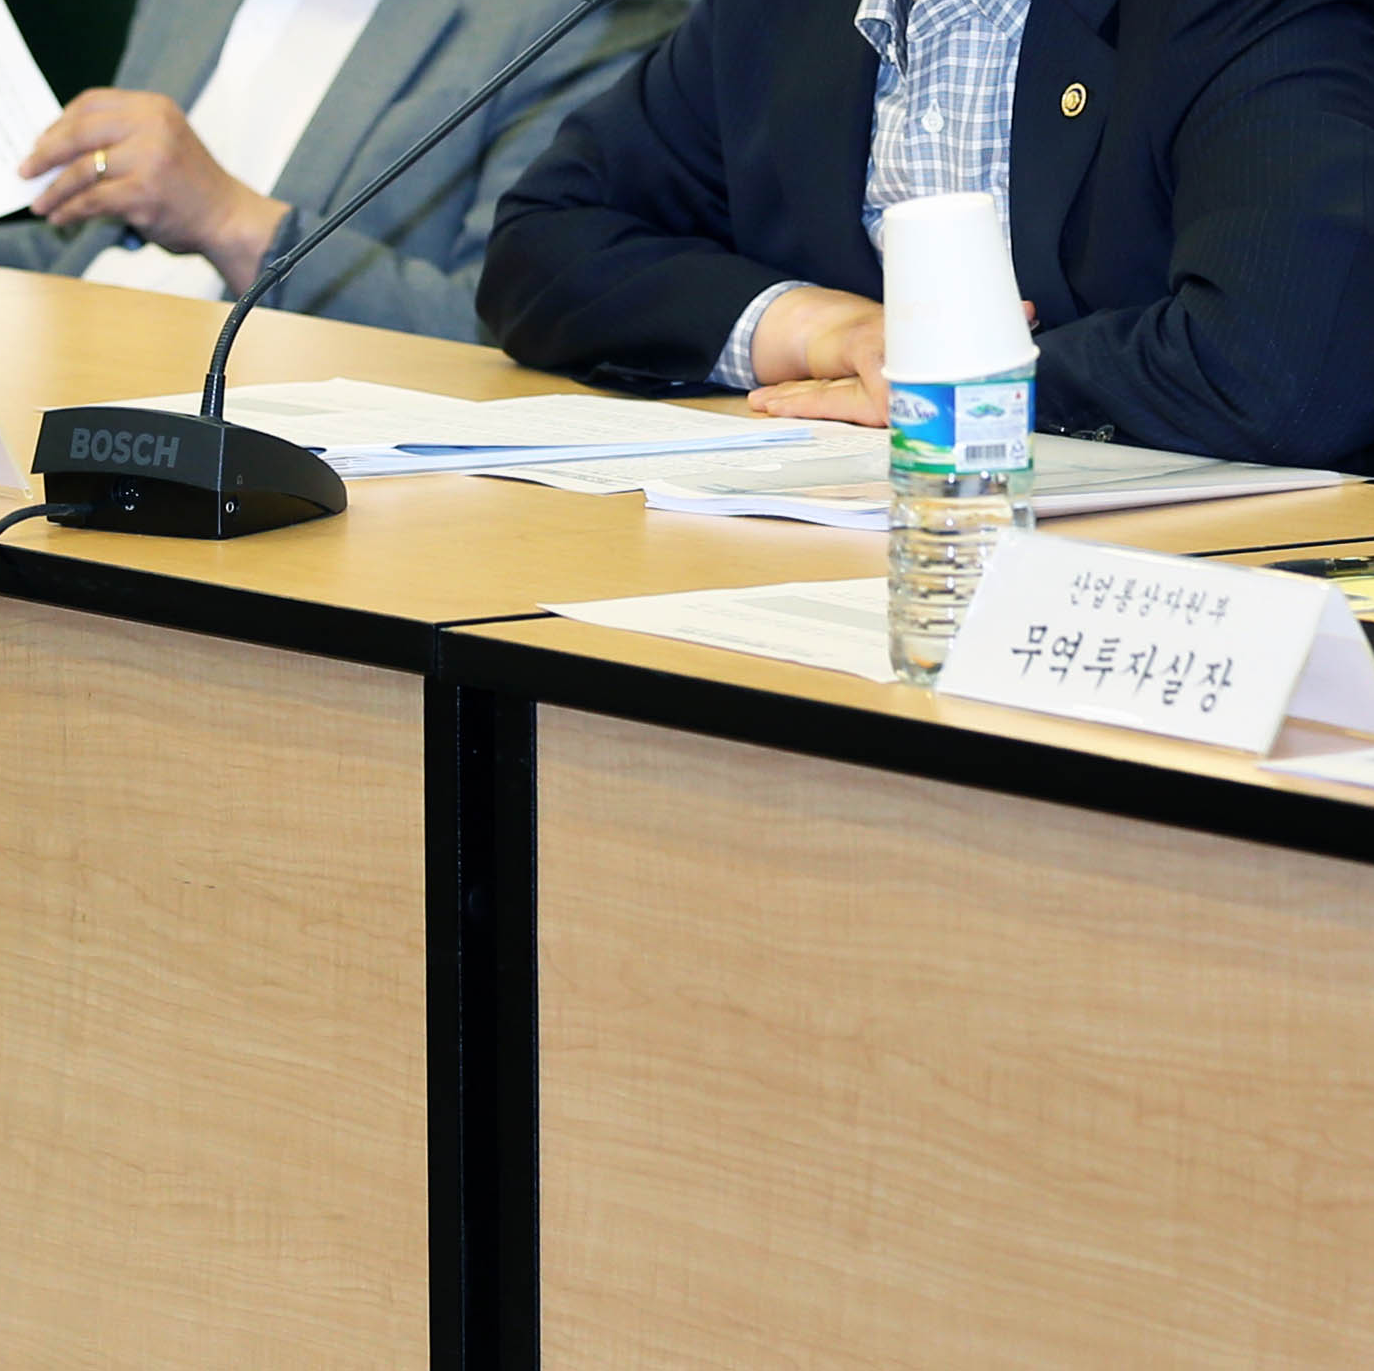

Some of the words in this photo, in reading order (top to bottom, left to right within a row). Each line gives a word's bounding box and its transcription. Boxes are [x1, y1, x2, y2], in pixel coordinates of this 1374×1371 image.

[70, 427, 181, 469] BOSCH
[1070, 571, 1231, 626] 산업통상자원부
[1011, 624, 1234, 712] 무역투자실장
